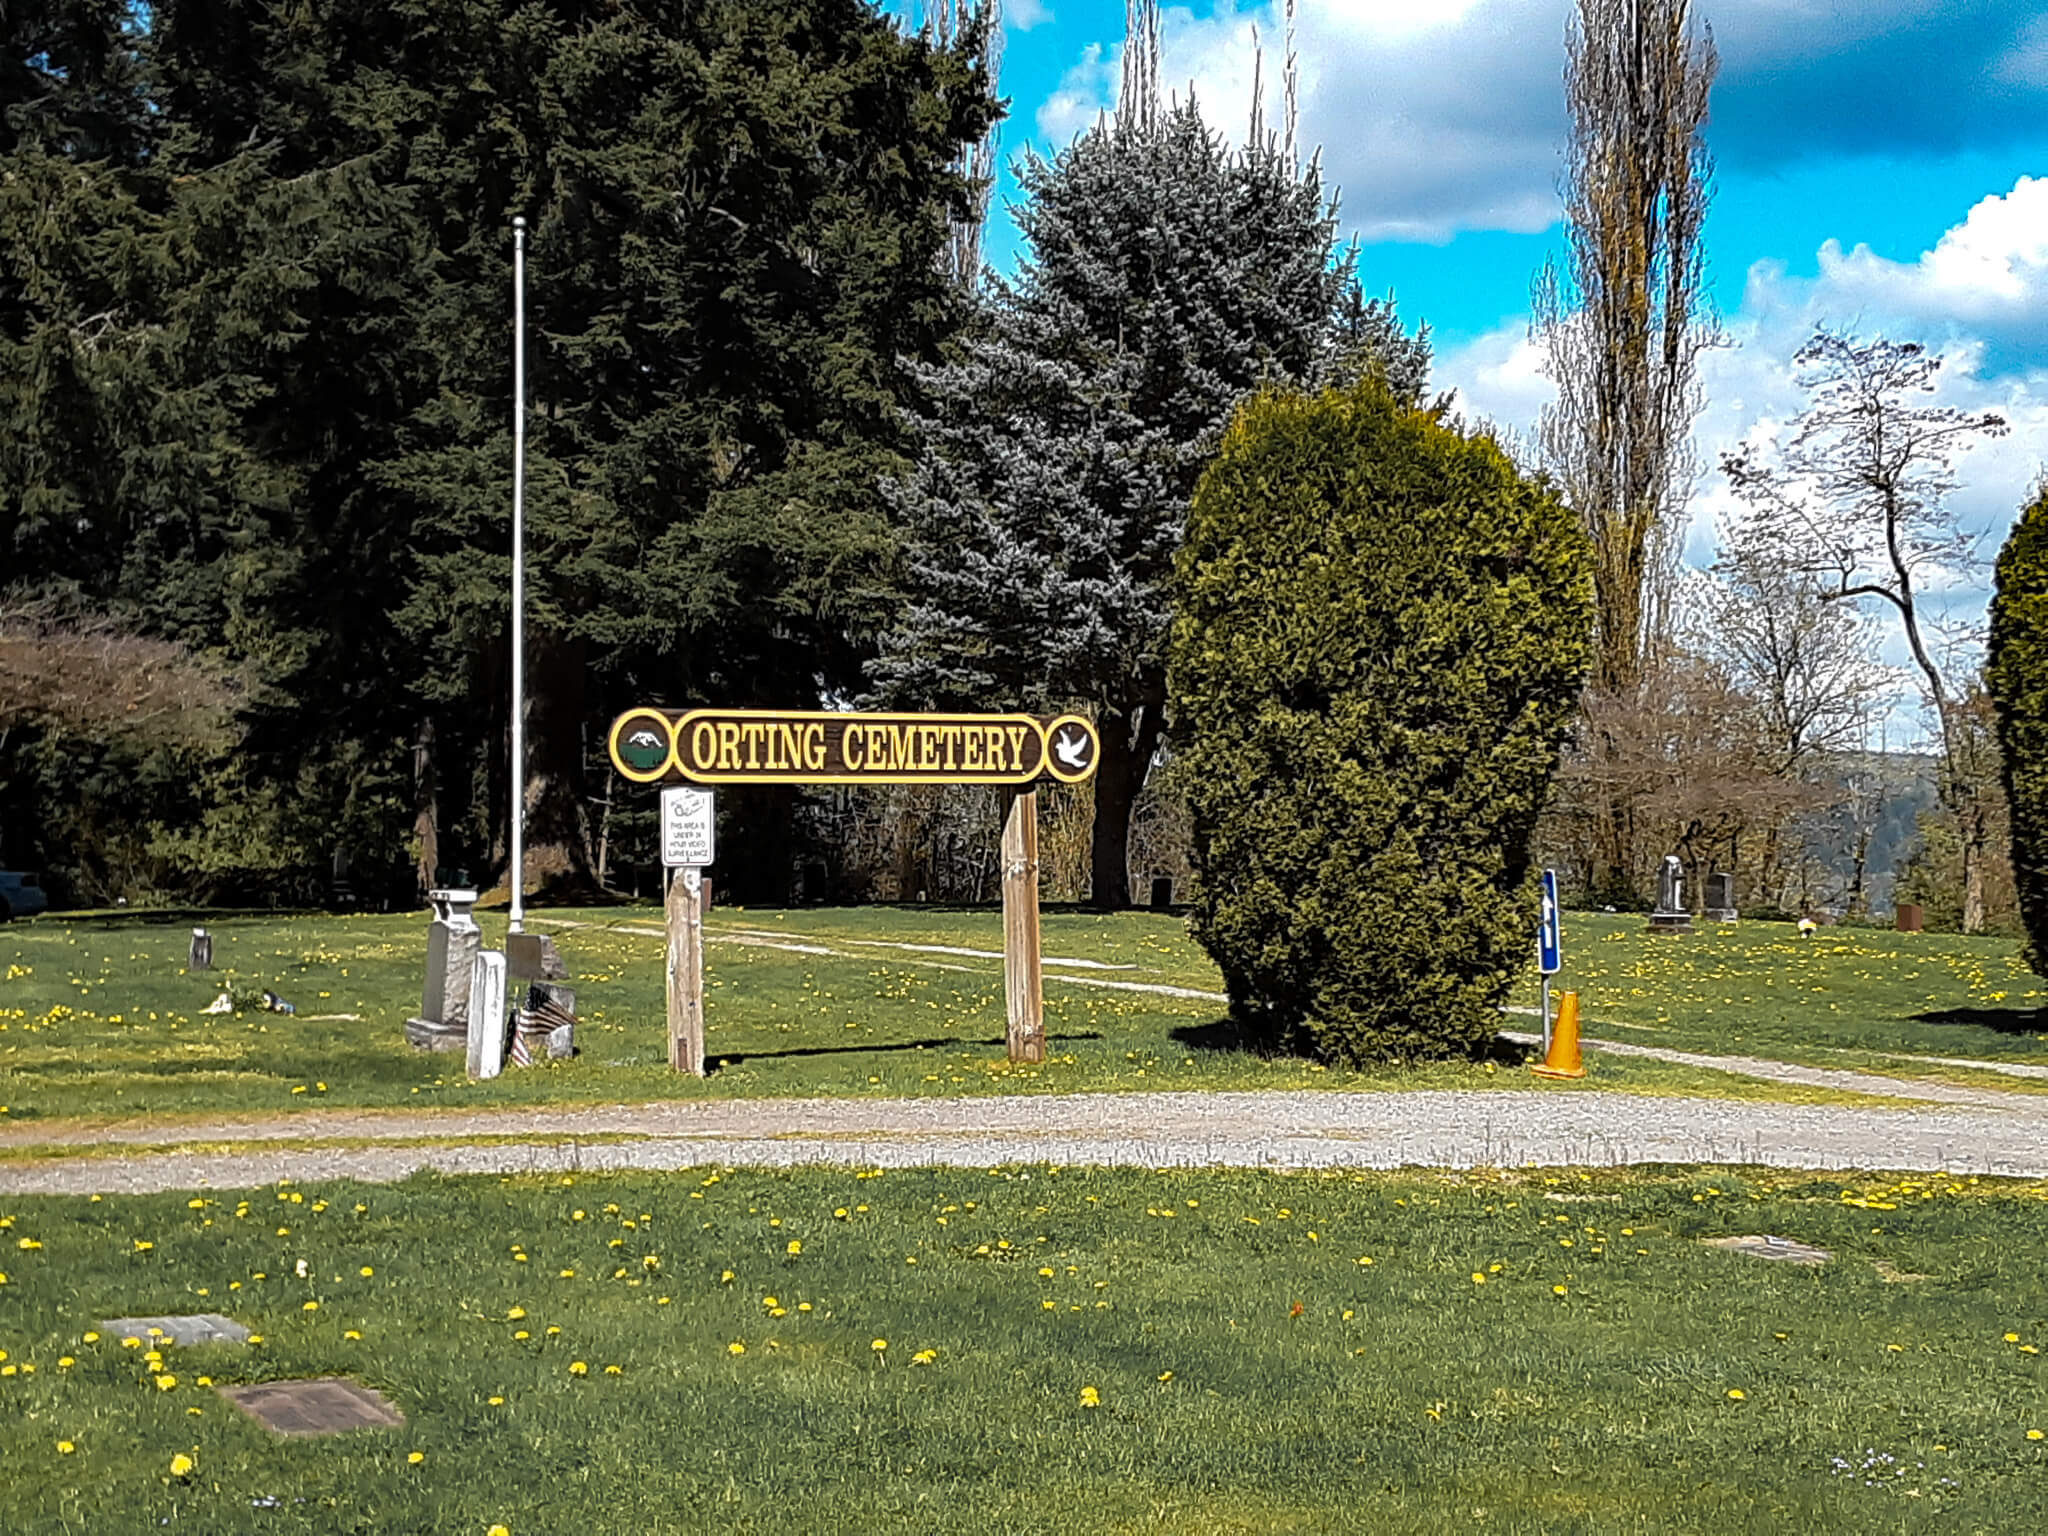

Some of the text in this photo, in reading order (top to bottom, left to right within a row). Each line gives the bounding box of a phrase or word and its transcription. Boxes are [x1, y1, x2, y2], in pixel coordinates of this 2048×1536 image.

[692, 721, 1028, 771] ORTING CEMETERY
[684, 822, 698, 830] AREA
